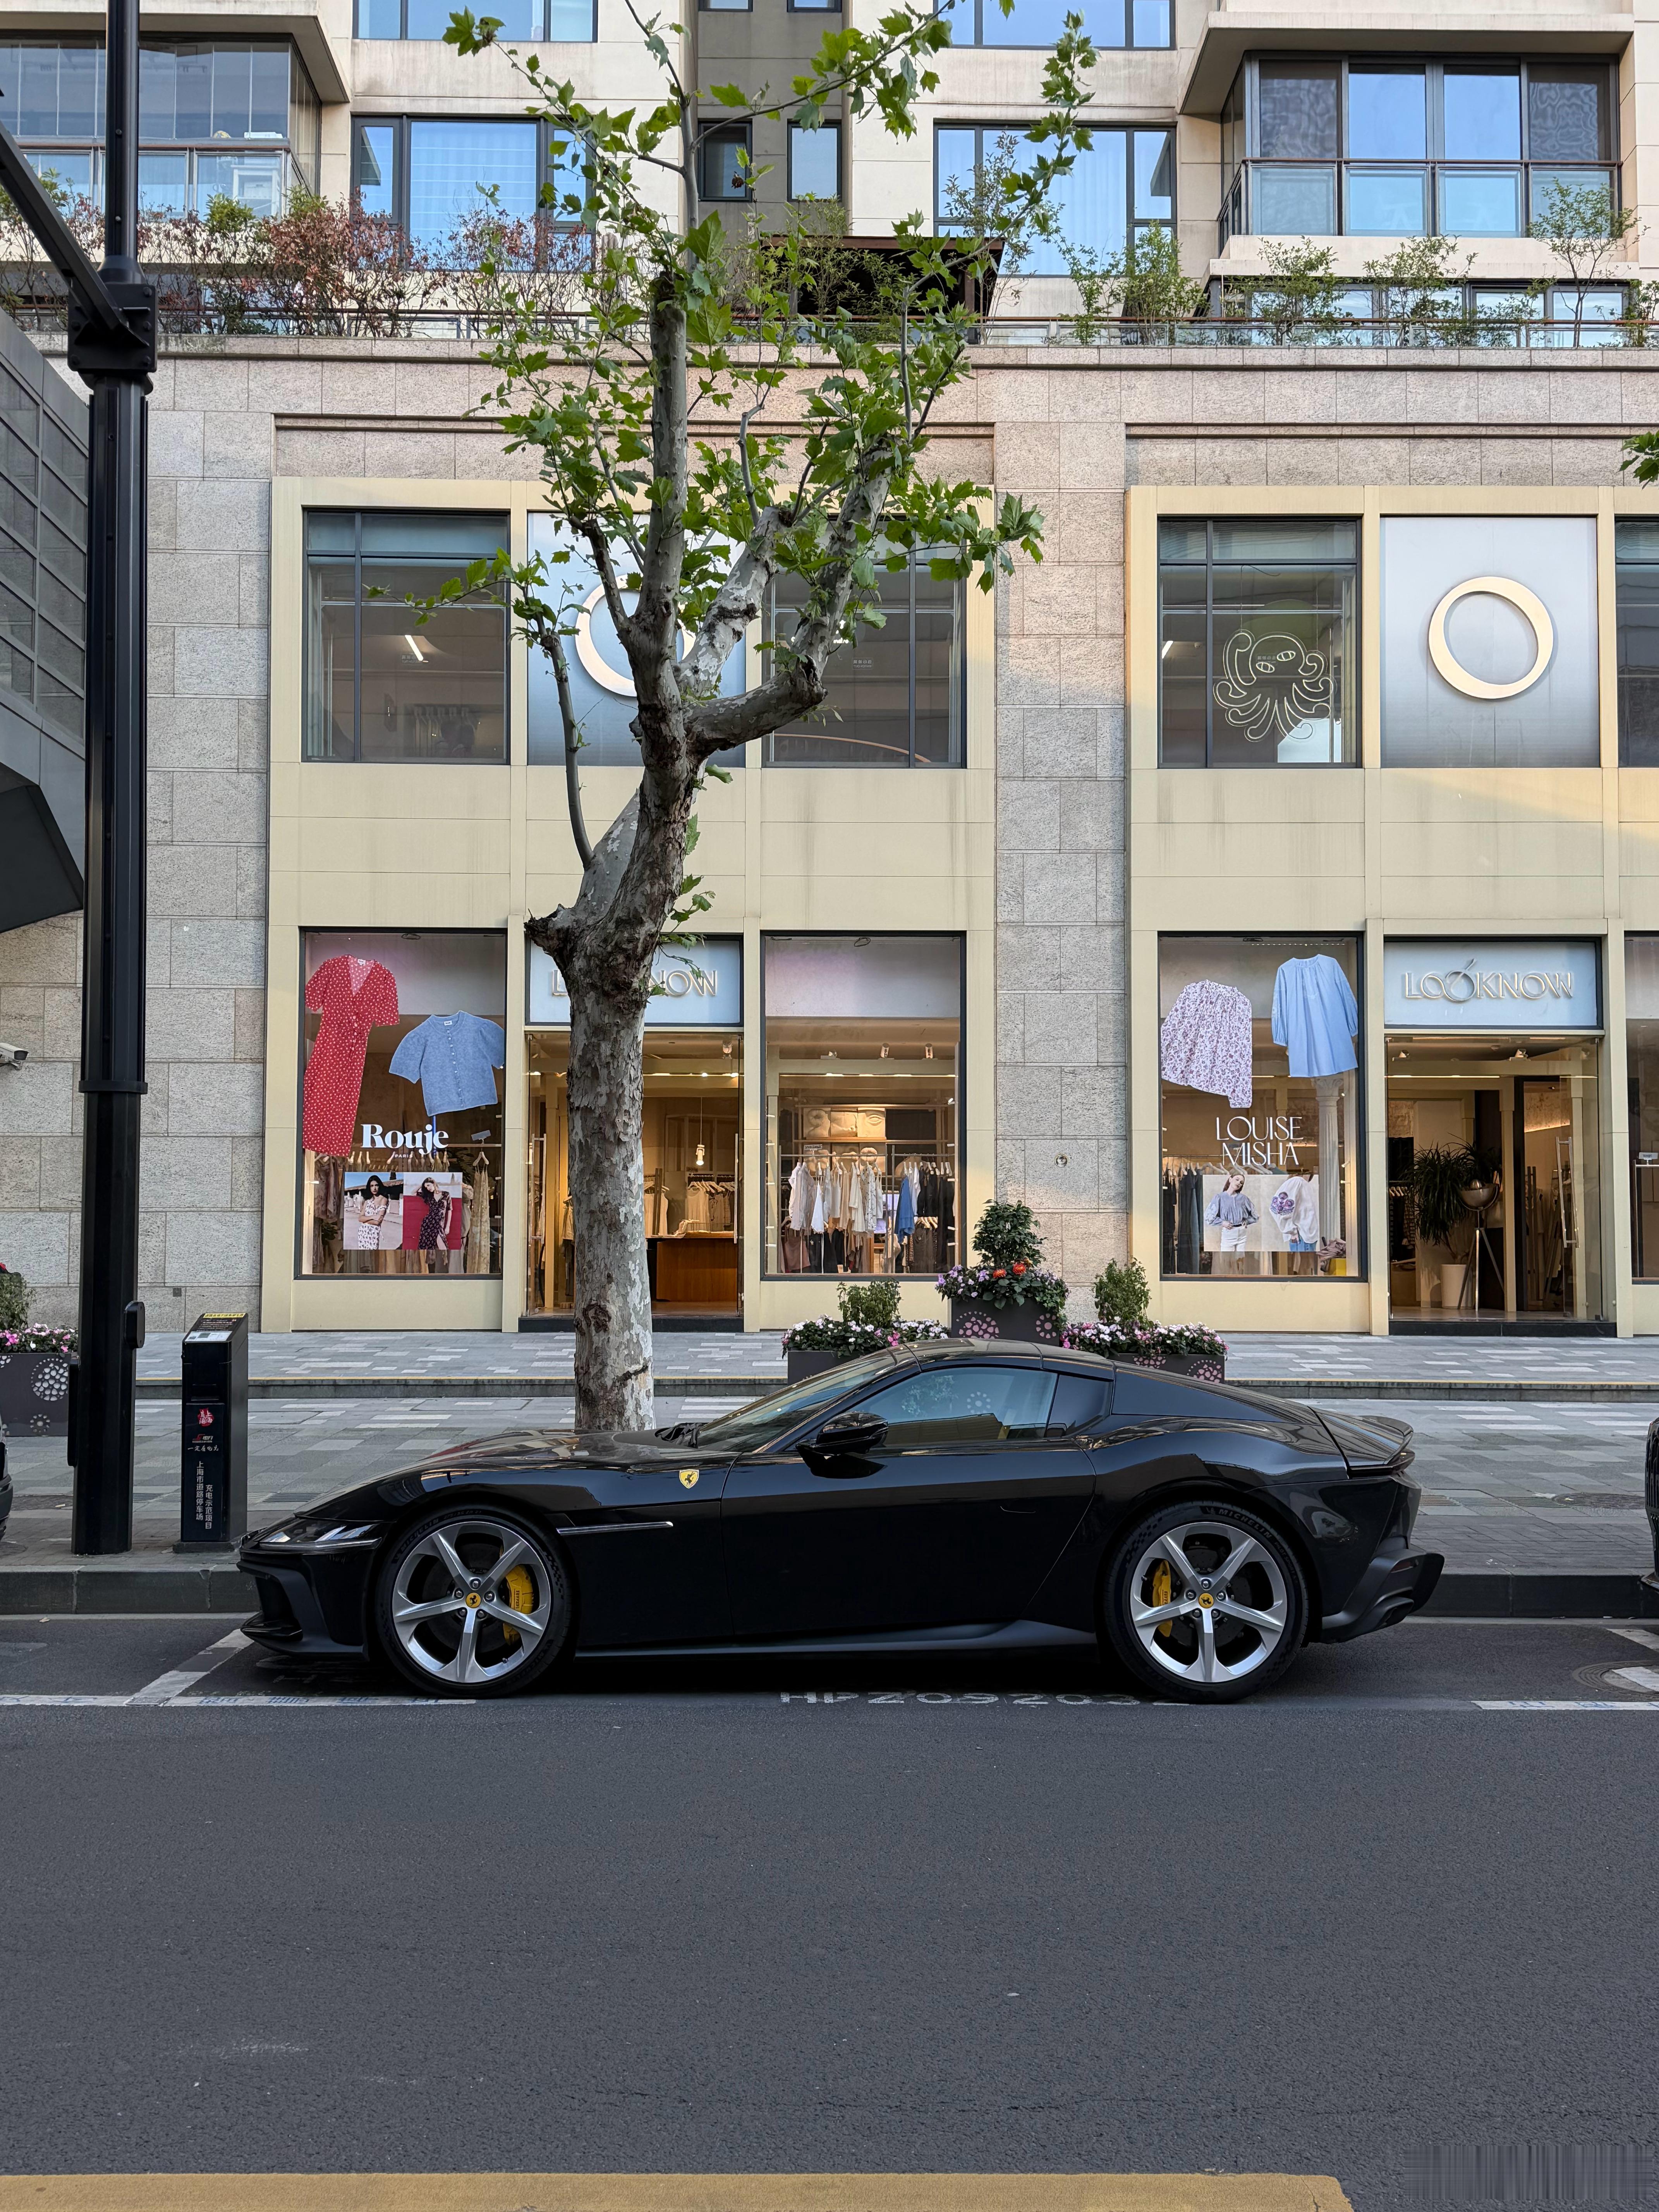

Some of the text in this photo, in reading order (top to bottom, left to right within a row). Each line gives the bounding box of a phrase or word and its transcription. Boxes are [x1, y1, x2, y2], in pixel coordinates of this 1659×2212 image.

[361, 1124, 449, 1155] Rouje
[1216, 1116, 1304, 1141] LOUISE
[1223, 1142, 1299, 1166] MISHA
[196, 1461, 204, 1521] 上海市道路停车场
[1218, 1509, 1272, 1539] MICHELIN
